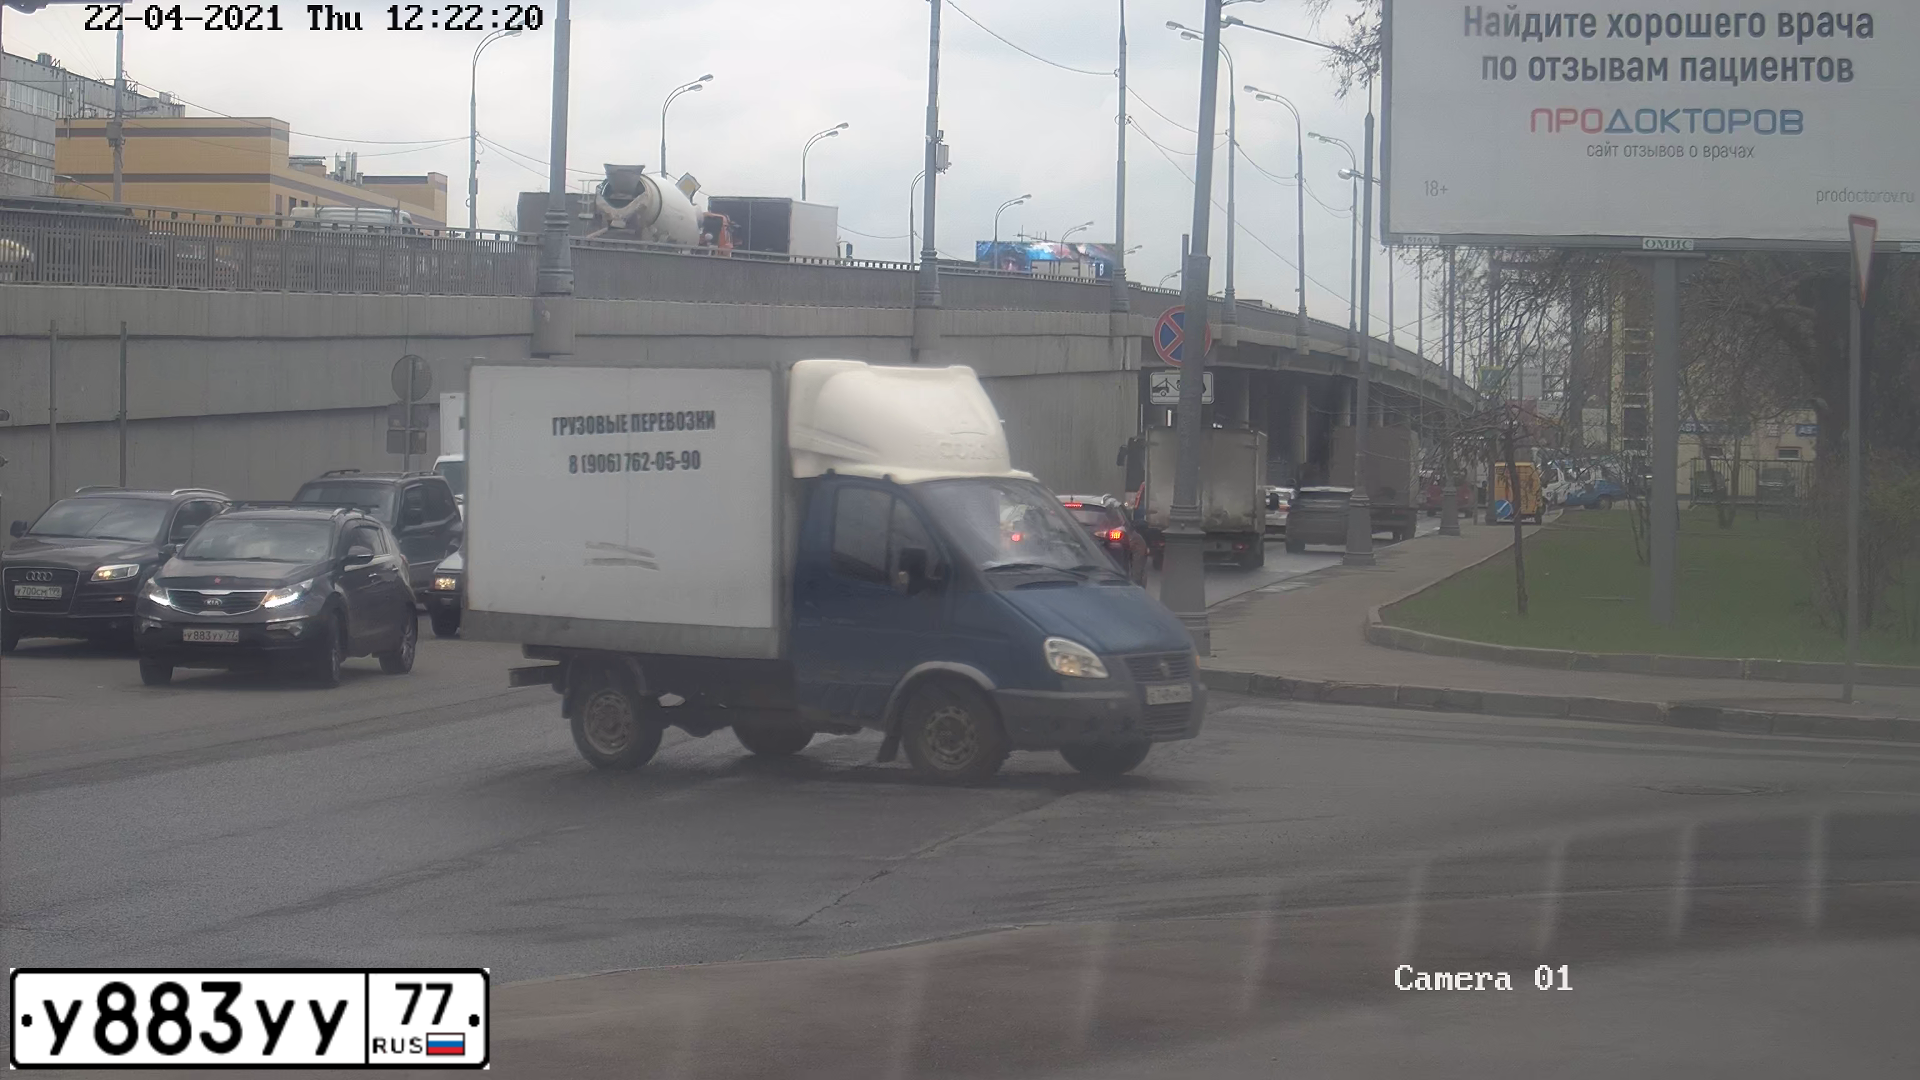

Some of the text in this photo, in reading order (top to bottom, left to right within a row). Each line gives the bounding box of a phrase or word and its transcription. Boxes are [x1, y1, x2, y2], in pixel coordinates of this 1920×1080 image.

[1464, 5, 1874, 45] Найдите хорошего врача
[1482, 55, 1854, 86] по отзывам пациентов
[1530, 108, 1804, 135] ПРОДОКТОРОВ
[1587, 141, 1755, 161] сайт отзывов о врачах
[1424, 180, 1449, 197] 18+
[1816, 187, 1915, 205] prodoctorov.ru
[1645, 239, 1692, 249] ОМИС
[552, 410, 716, 436] ГРУЗОВЫЕ ПЕРЕВОЗКИ
[569, 455, 578, 474] 8
[624, 450, 702, 472] 762-05-90
